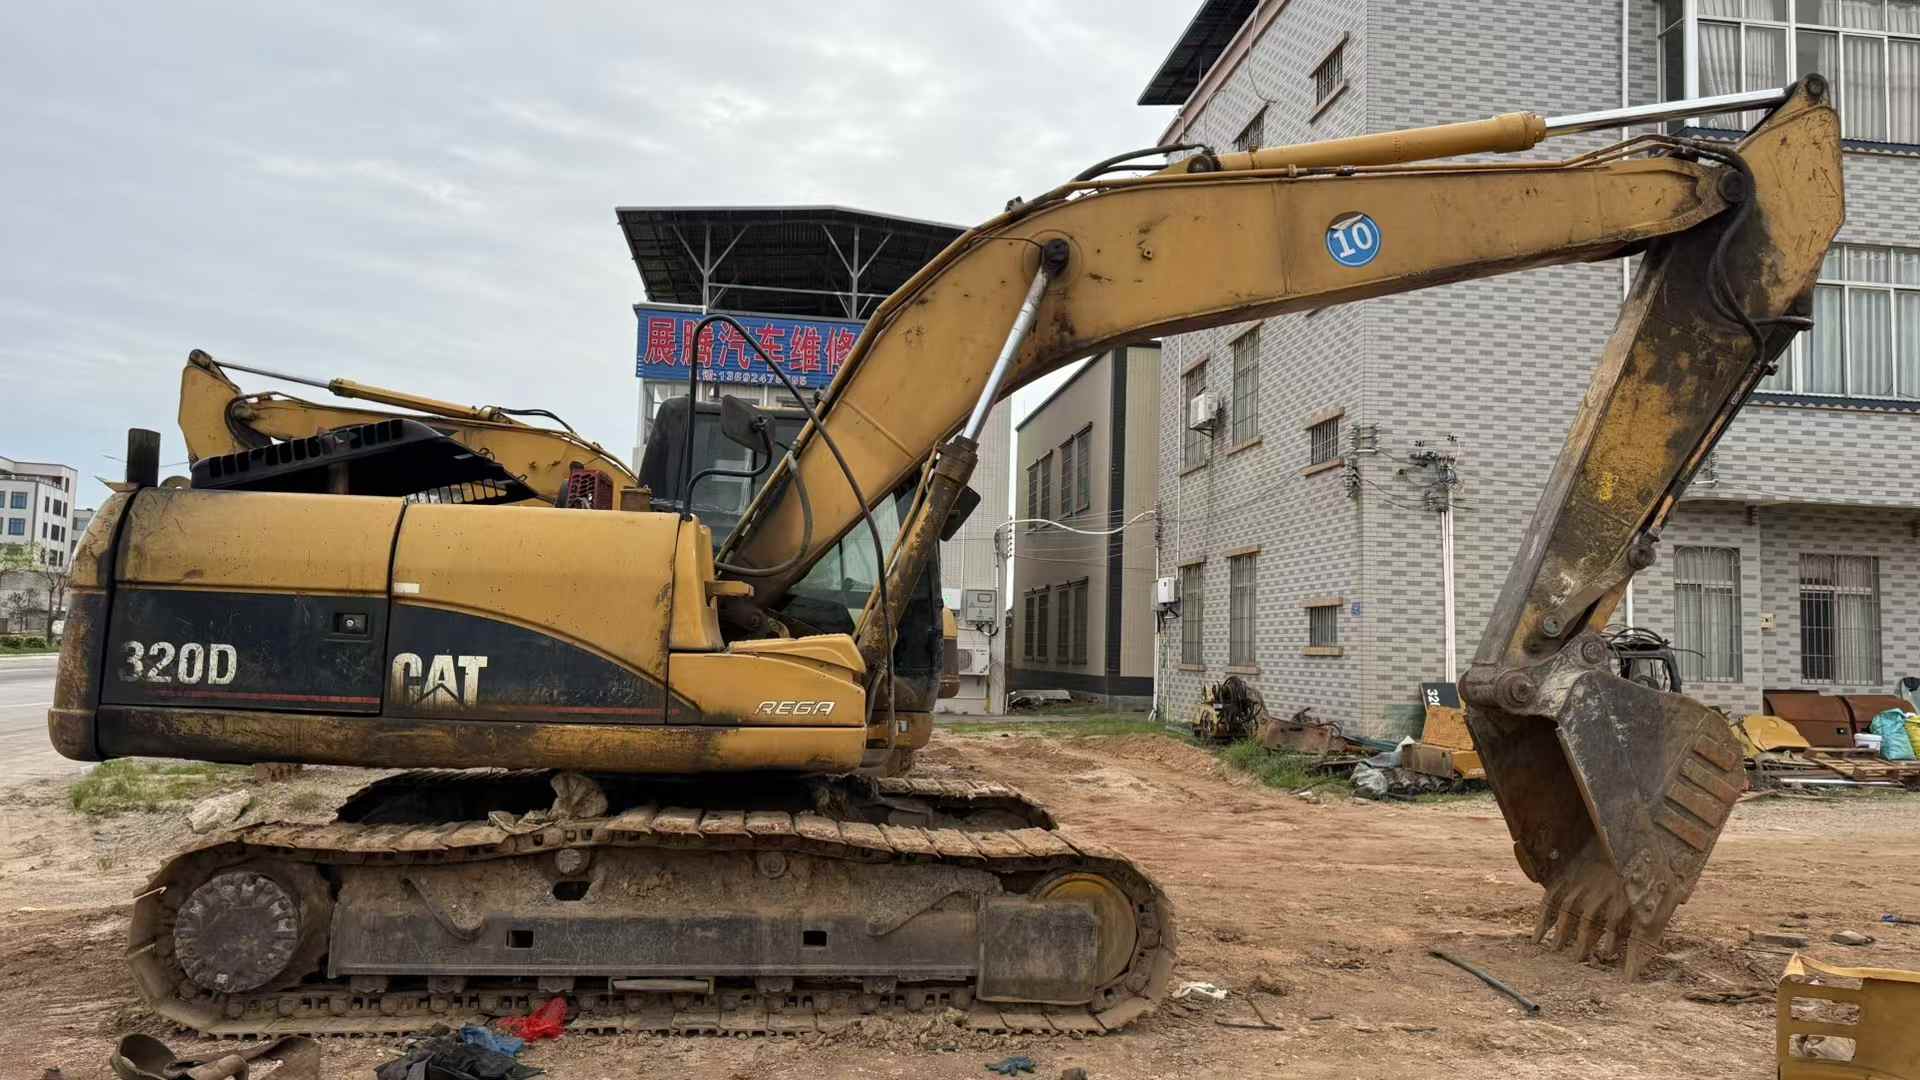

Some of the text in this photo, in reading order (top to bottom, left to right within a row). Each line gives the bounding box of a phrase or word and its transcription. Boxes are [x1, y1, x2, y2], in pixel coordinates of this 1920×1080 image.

[1333, 222, 1373, 258] 10
[117, 641, 238, 684] 320D
[390, 652, 488, 706] CAT
[754, 701, 836, 715] REGA
